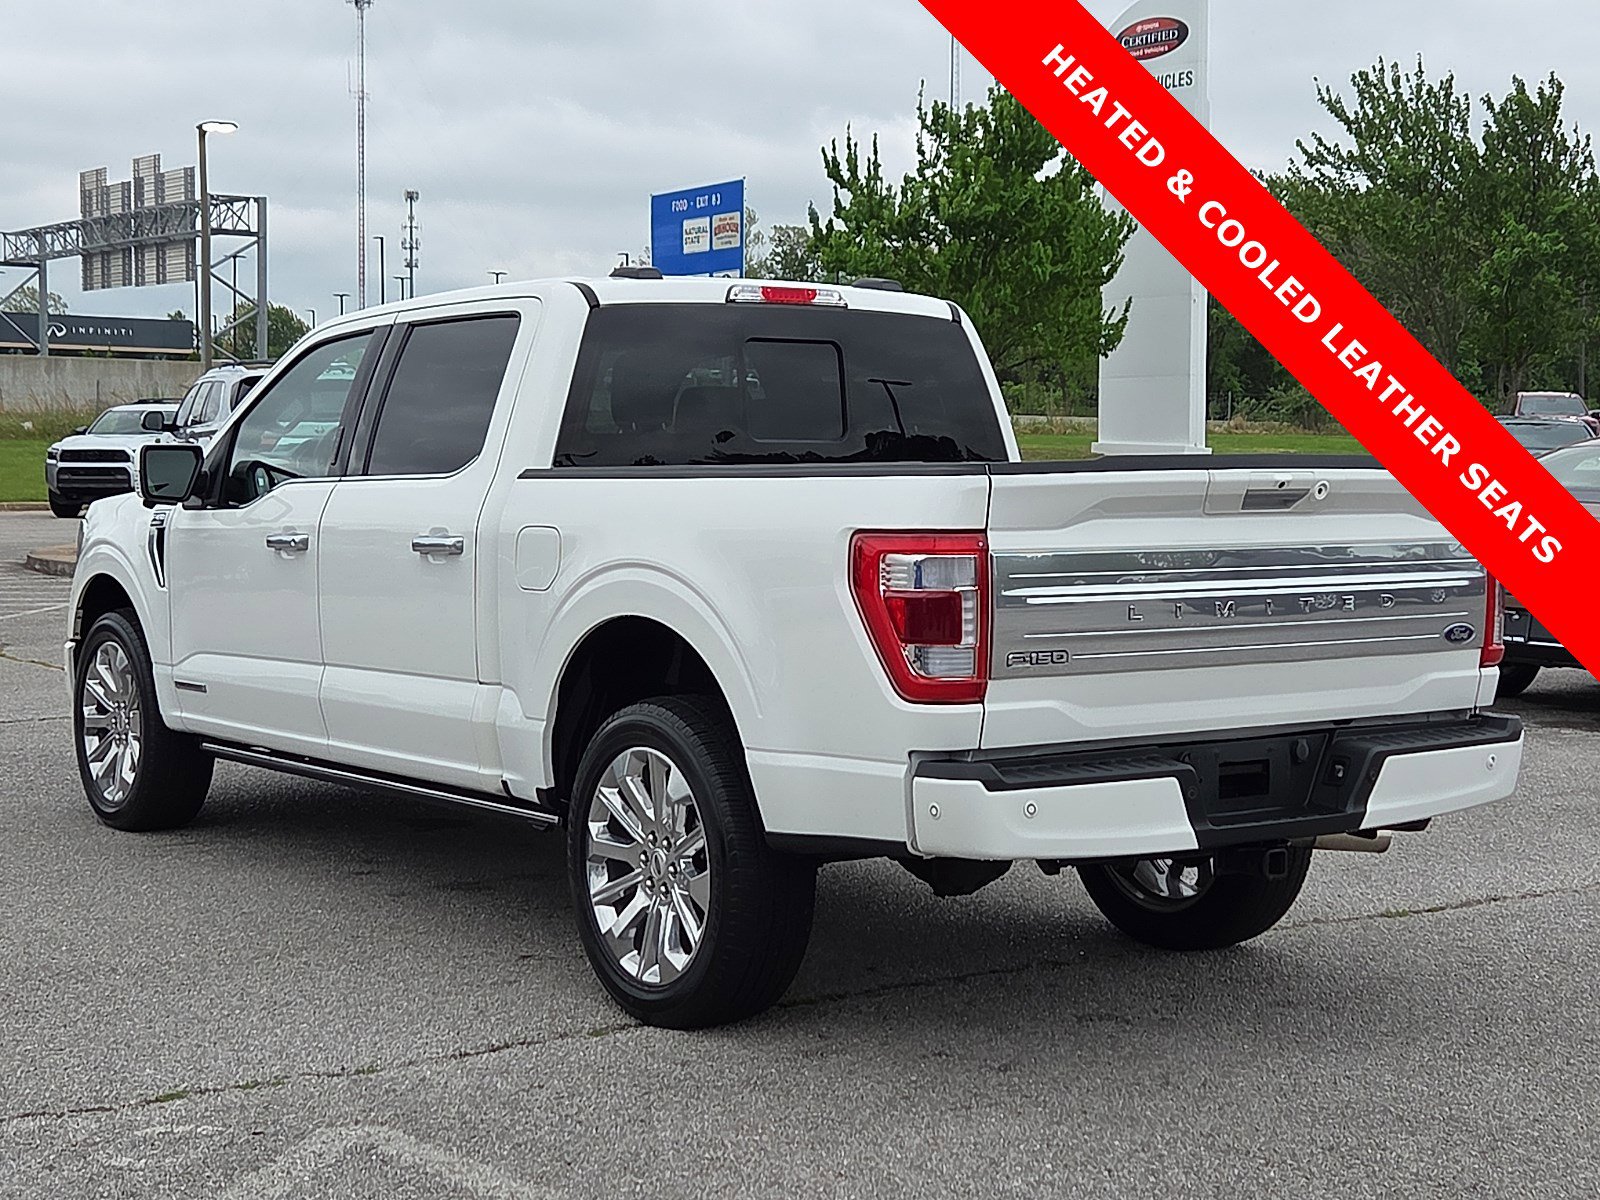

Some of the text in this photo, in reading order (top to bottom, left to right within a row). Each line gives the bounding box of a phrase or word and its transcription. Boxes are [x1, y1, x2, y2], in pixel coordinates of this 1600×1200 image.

[1121, 29, 1179, 48] CERTIFIED
[1155, 71, 1193, 90] ICLES
[671, 199, 688, 212] FOOD
[696, 195, 708, 208] EXIT
[684, 225, 708, 236] NATURAL
[684, 235, 701, 245] STATE
[71, 326, 134, 337] INFINITI
[1128, 593, 1396, 621] LIMITED
[1450, 627, 1470, 640] Ford
